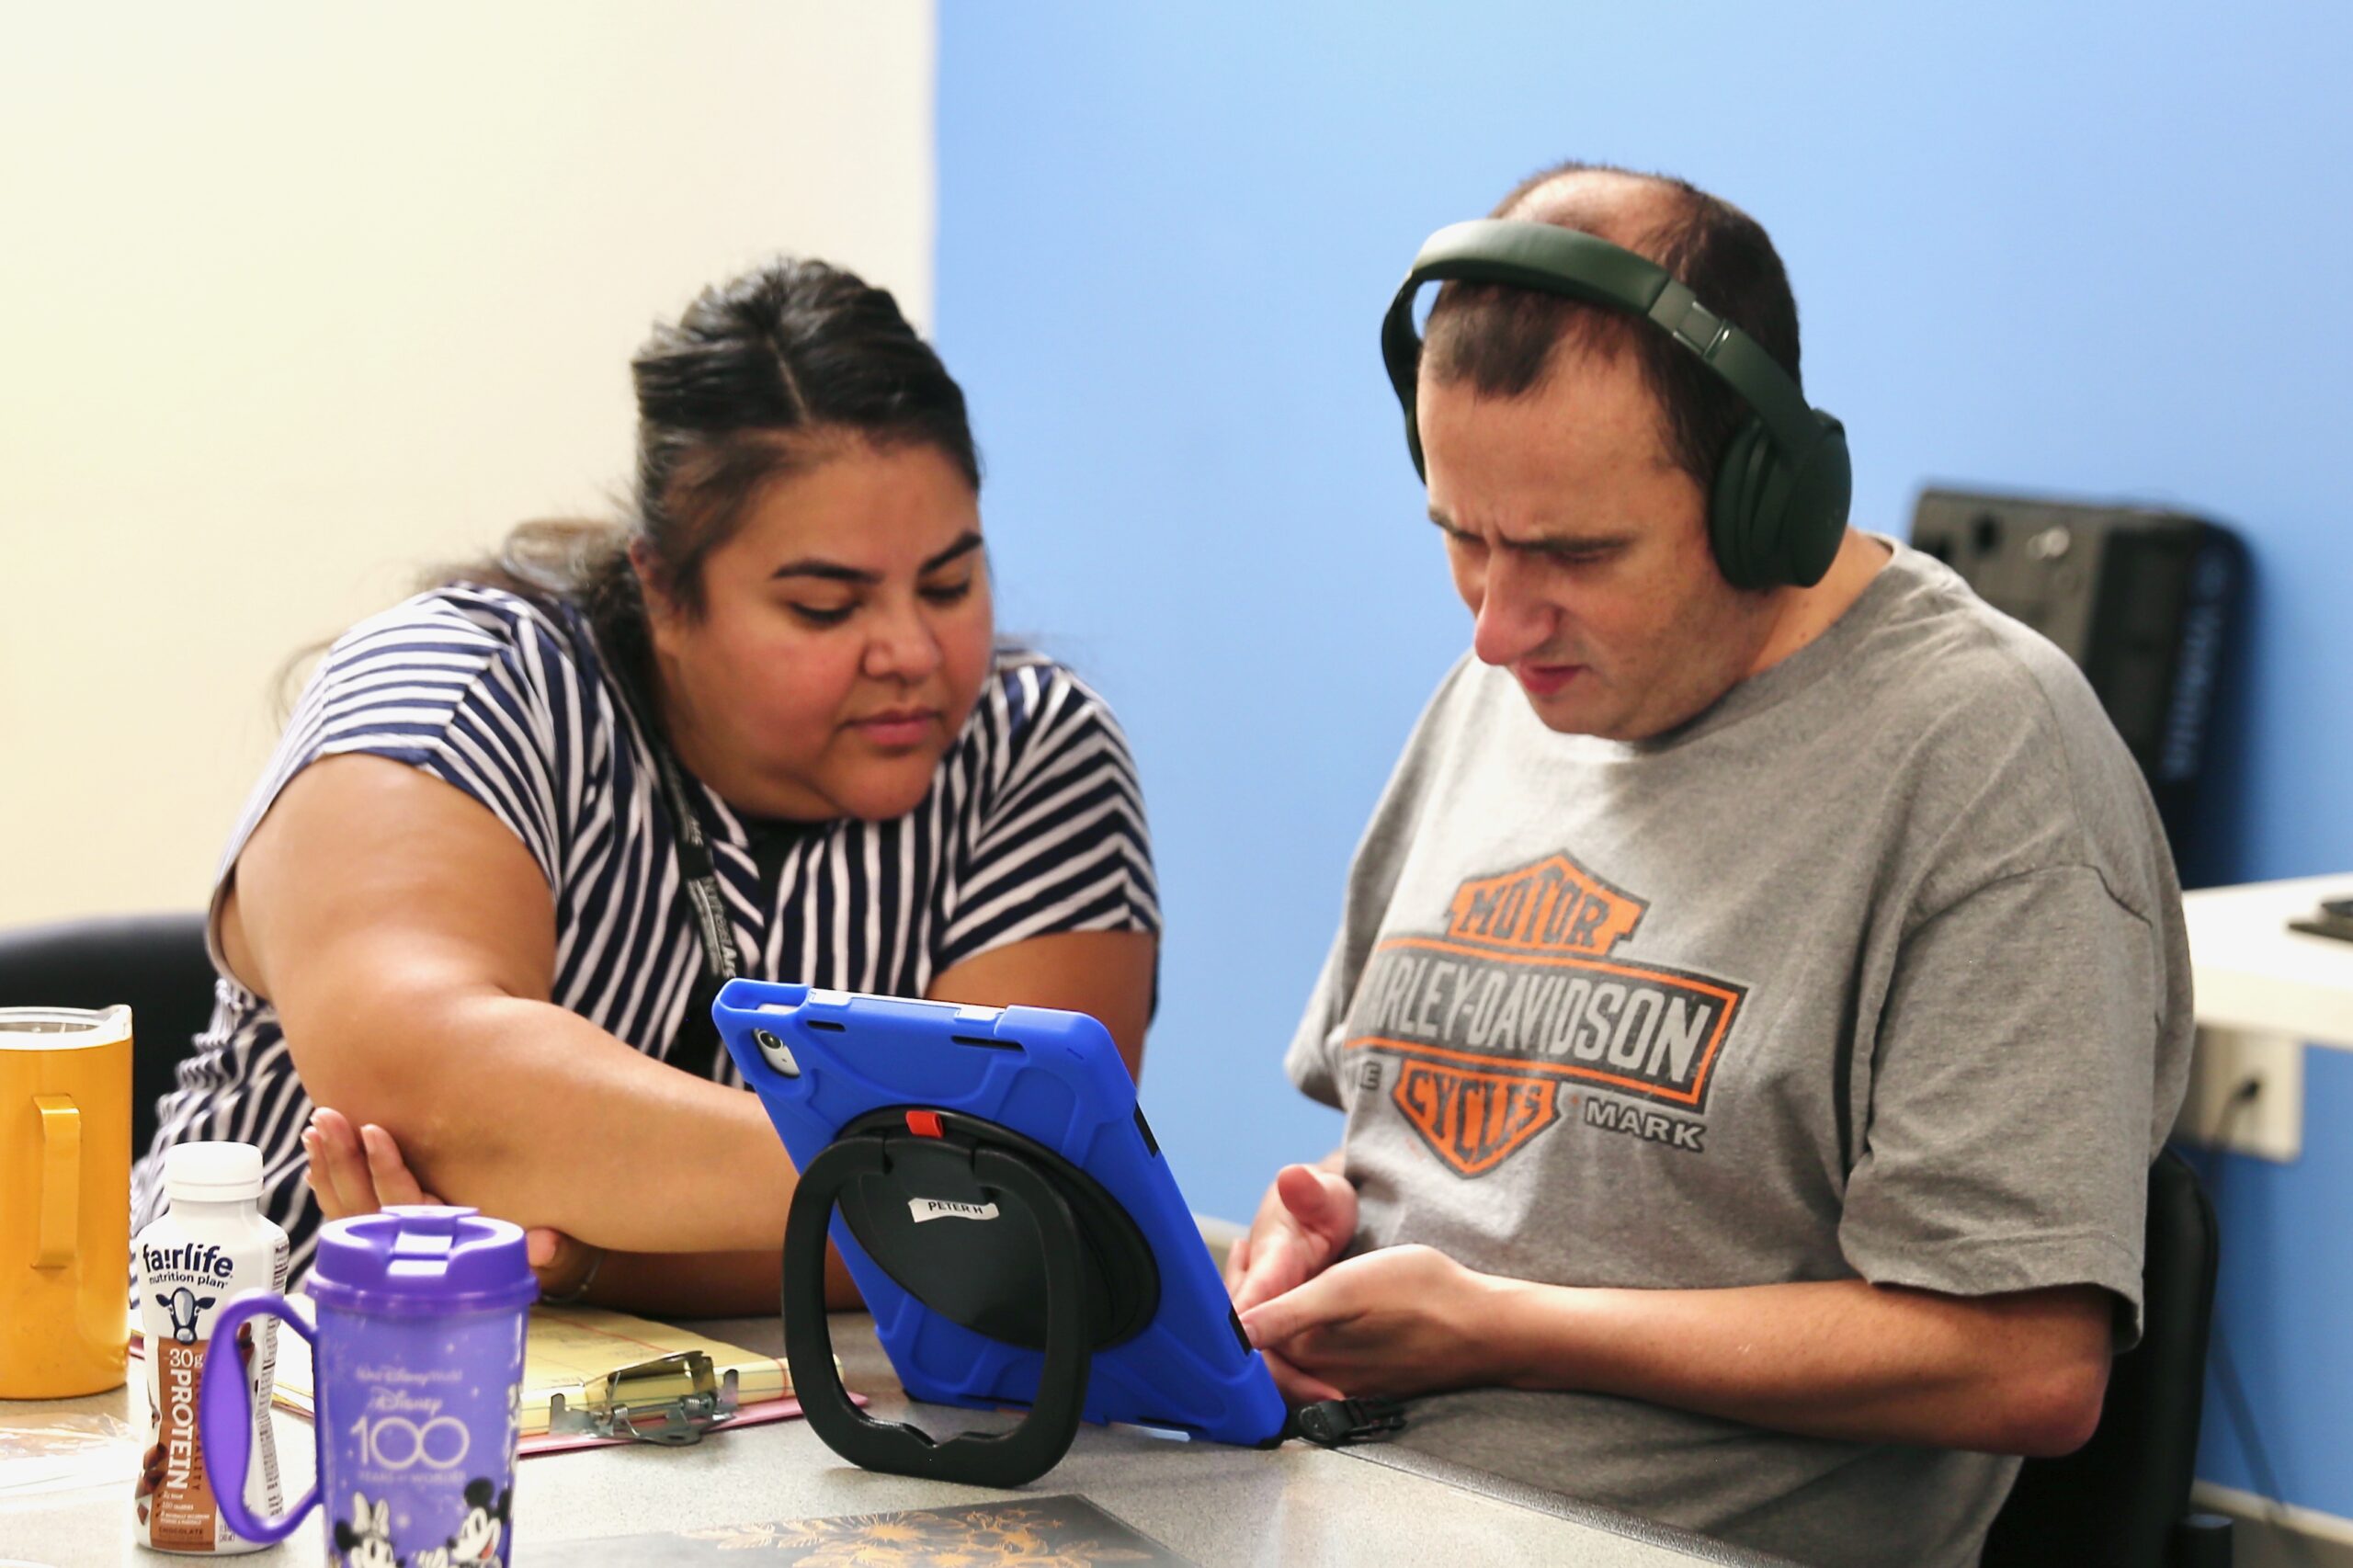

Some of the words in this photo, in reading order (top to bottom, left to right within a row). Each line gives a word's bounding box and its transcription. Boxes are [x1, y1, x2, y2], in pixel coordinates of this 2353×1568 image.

[1458, 865, 1611, 949] MOTOR
[1405, 1070, 1543, 1158] CYCLES
[1584, 1096, 1707, 1153] MARK
[928, 1201, 971, 1212] PETER
[973, 1205, 983, 1214] H
[149, 1271, 194, 1285] nutrition
[197, 1274, 225, 1290] plan
[169, 1347, 204, 1369] 30g
[166, 1369, 195, 1490] PROTEIN
[369, 1386, 443, 1418] Disney
[350, 1415, 470, 1470] 100
